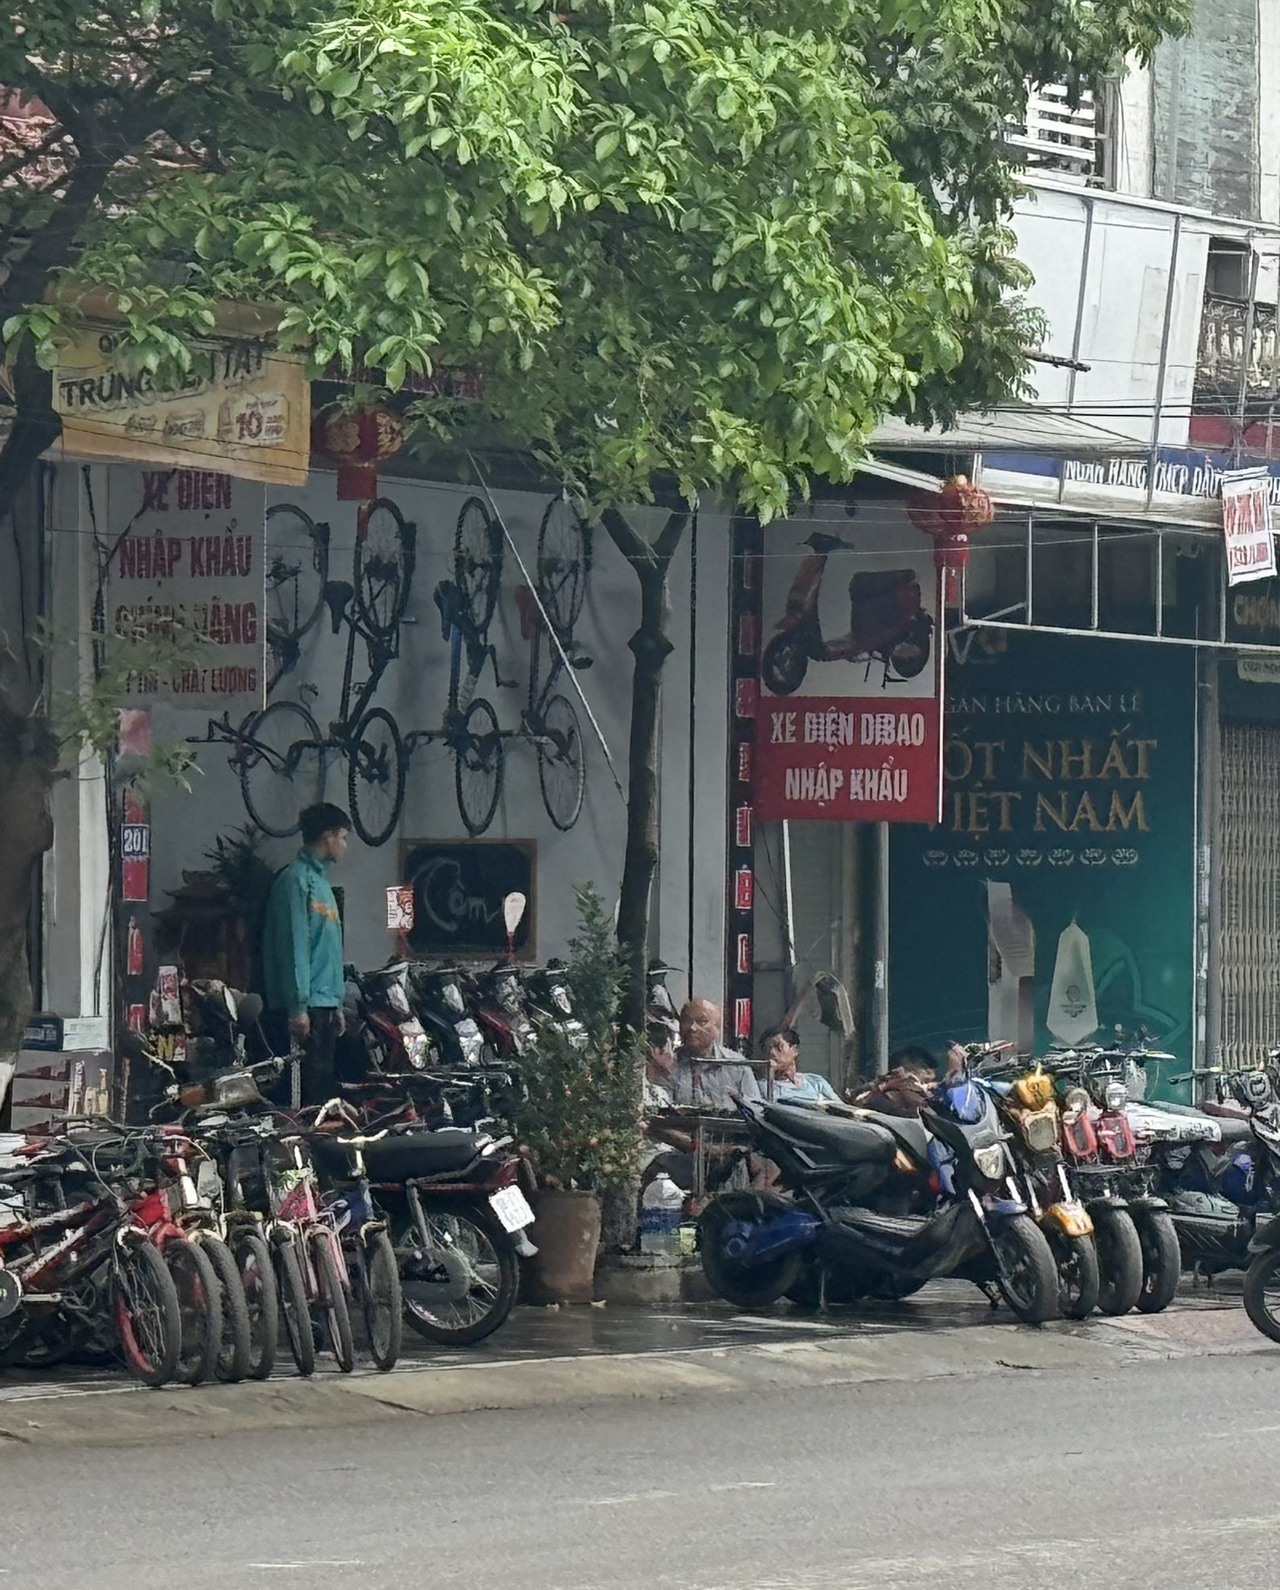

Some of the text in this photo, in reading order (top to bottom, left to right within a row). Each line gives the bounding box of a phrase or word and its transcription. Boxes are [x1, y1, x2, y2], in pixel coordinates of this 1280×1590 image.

[119, 518, 252, 587] NHẬP KHẨU
[770, 711, 797, 744] XE
[1022, 723, 1158, 781] NHẤT
[785, 755, 908, 807] NHẬP KHẨU
[1033, 790, 1150, 833] NAM
